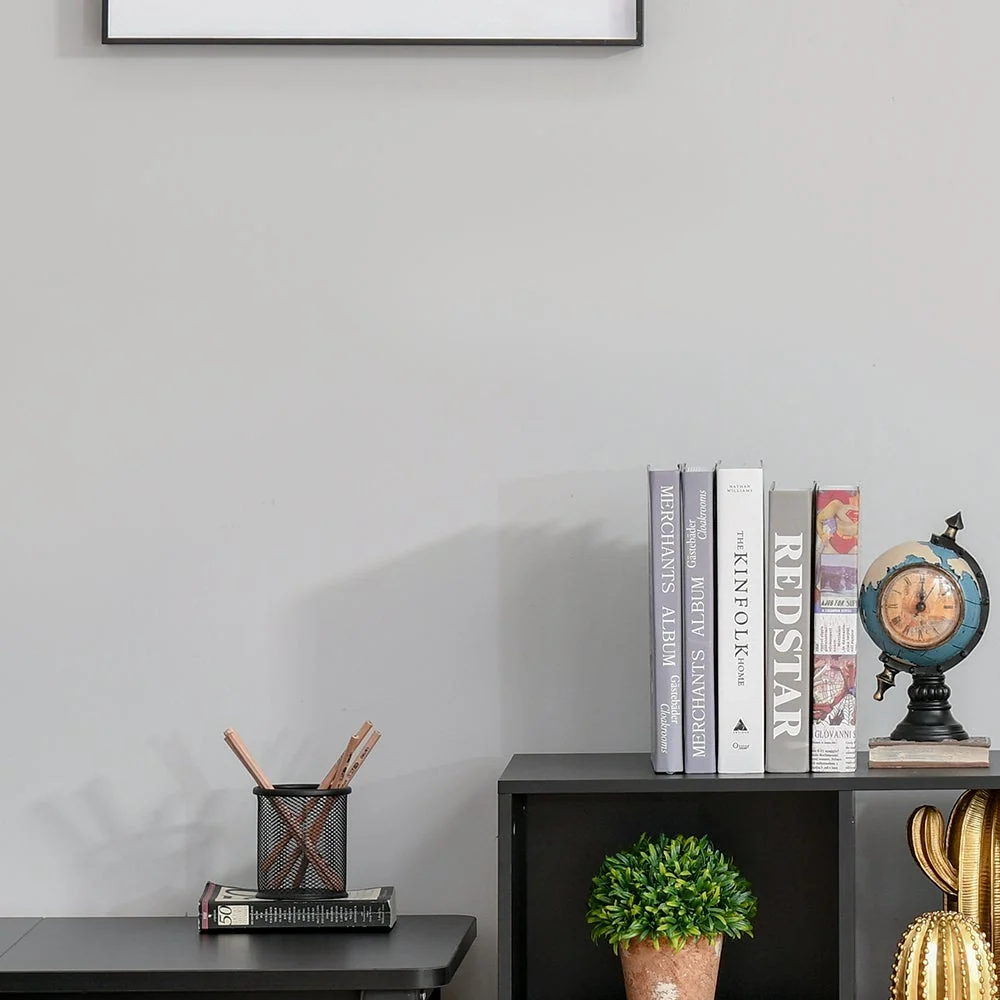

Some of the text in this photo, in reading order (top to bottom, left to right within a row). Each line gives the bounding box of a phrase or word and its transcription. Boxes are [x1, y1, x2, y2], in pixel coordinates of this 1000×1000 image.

[686, 519, 697, 568] Gästebäder
[697, 489, 707, 540] Cloakrooms
[660, 485, 676, 666] MERCHANTS ALBUM
[733, 552, 748, 656] KINFOLK
[691, 576, 706, 758] MERCHANTS ALBUM
[737, 656, 745, 687] HOME
[773, 532, 803, 739] REDSTAR
[218, 905, 232, 926] 50
